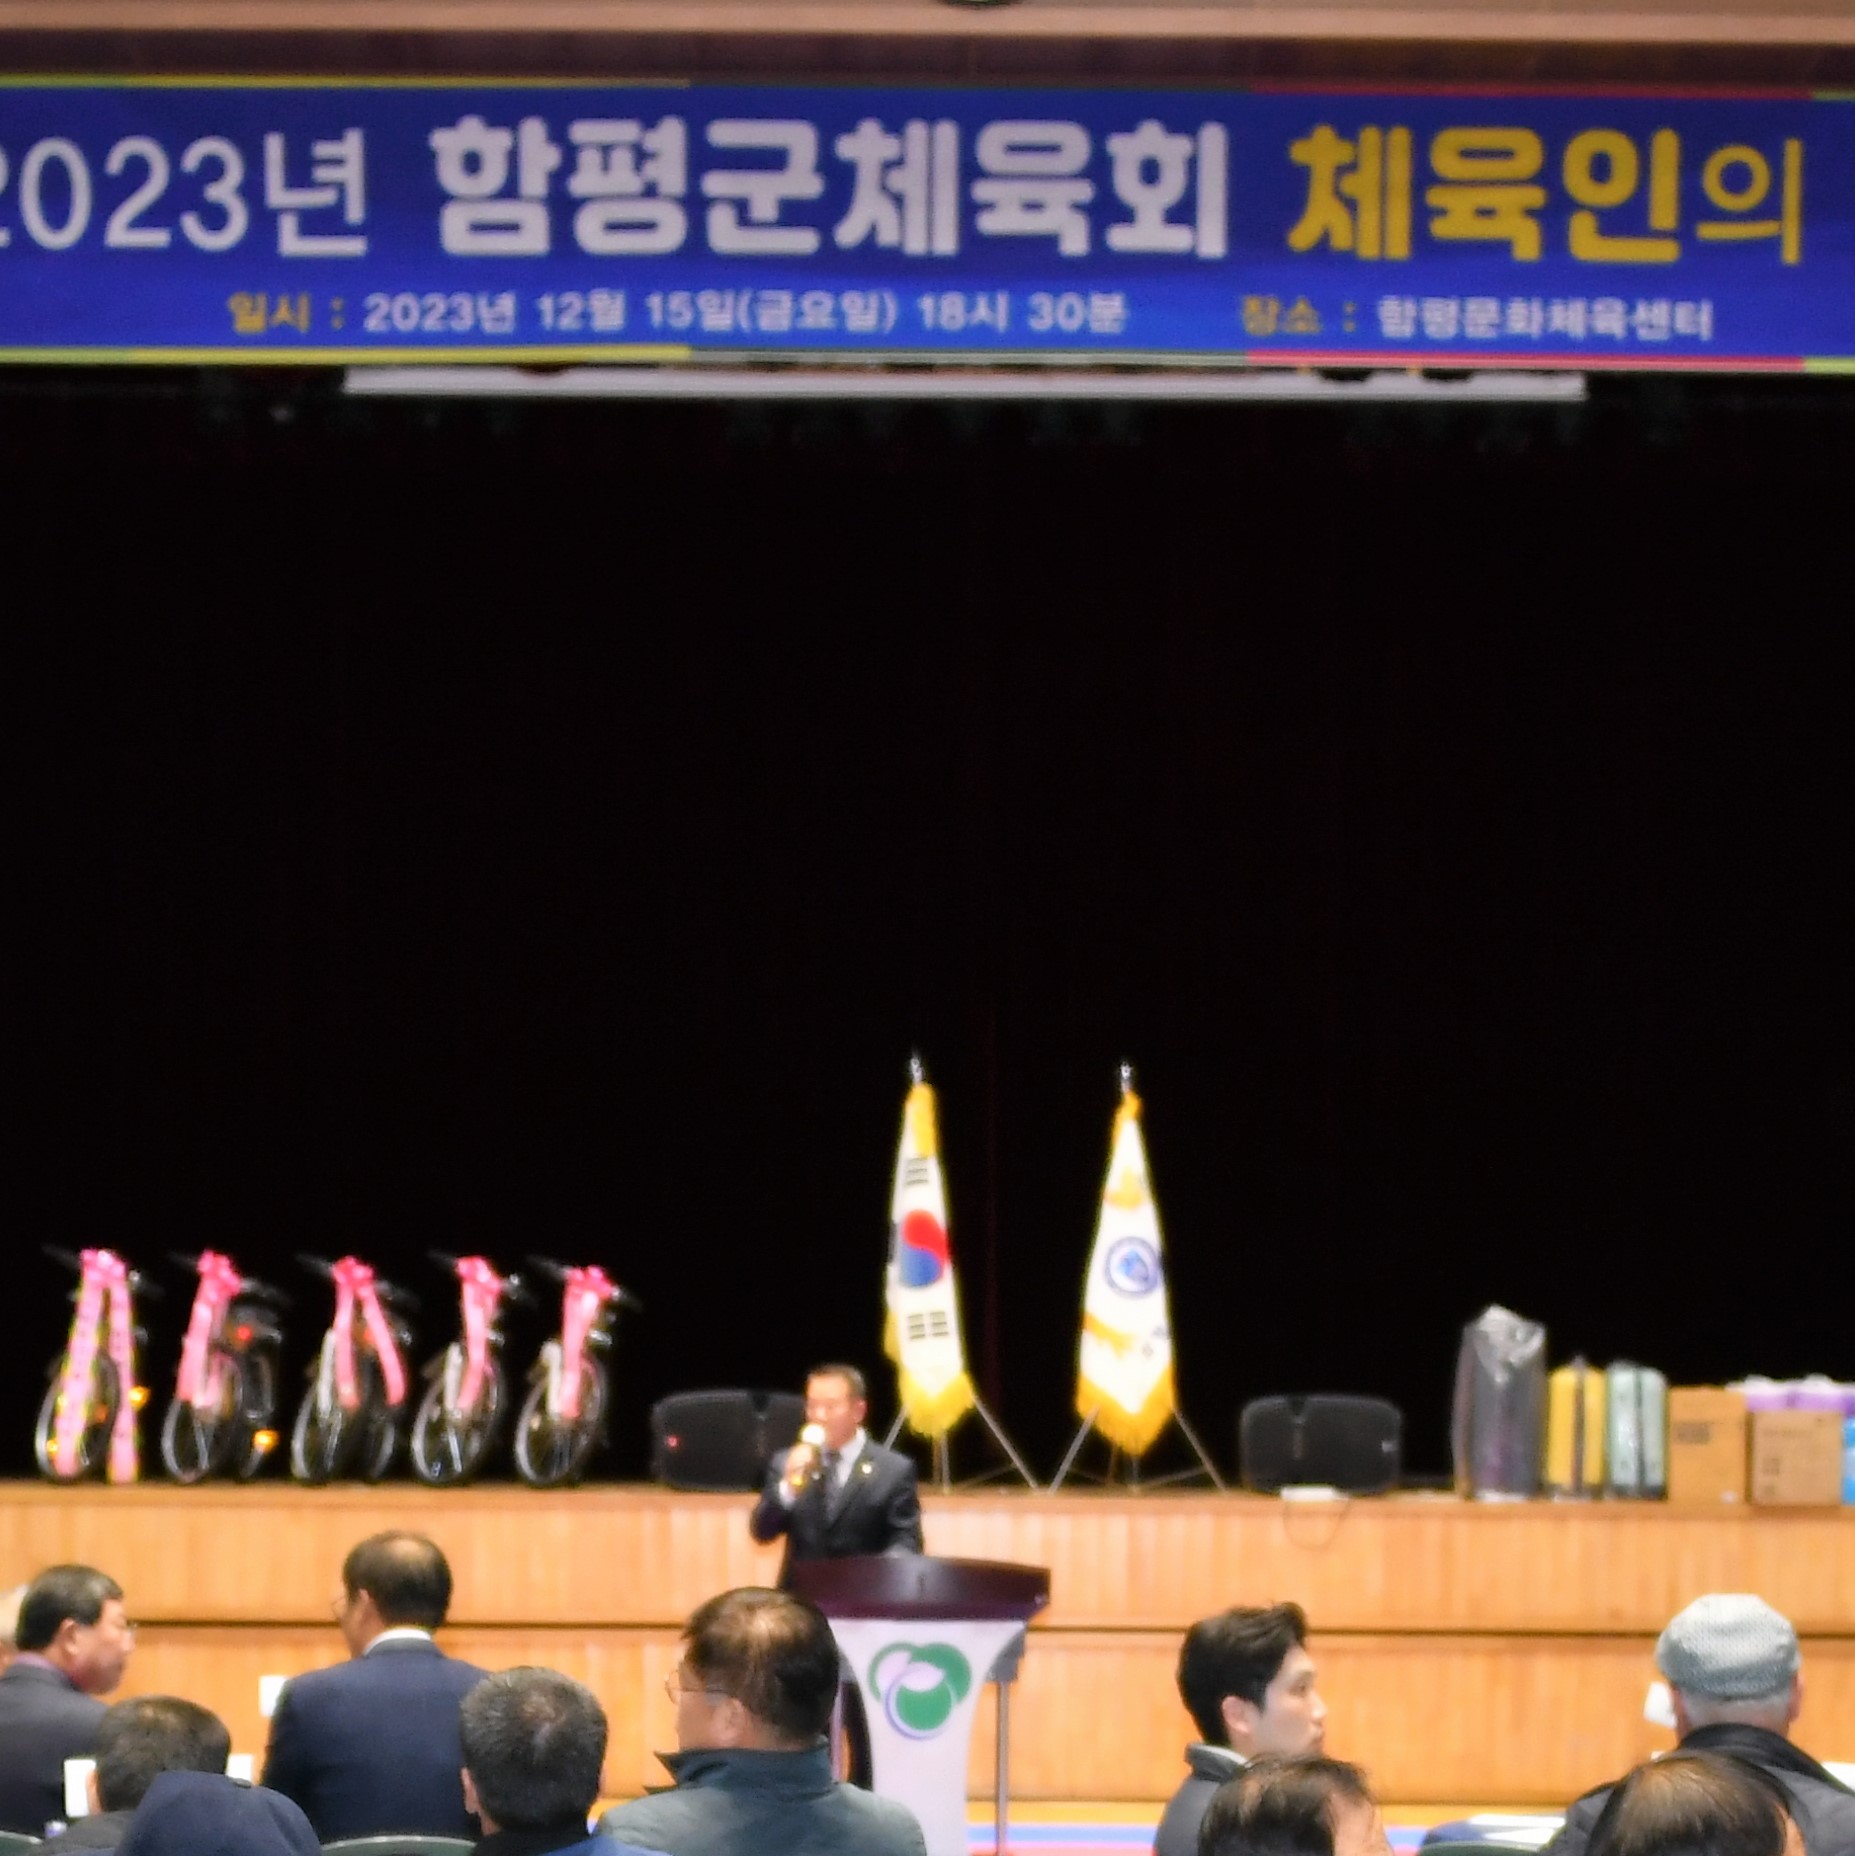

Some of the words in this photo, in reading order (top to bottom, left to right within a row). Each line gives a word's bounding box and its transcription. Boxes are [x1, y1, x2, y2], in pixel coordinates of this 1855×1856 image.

[428, 115, 1229, 261] 함평군체육회
[1286, 123, 1804, 266] 체육인의
[226, 291, 312, 335] 일시
[361, 290, 518, 334] 2023년
[537, 287, 628, 333] 12월
[645, 288, 899, 335] 15일(금요일)
[916, 290, 1011, 333] 18시
[1027, 290, 1129, 335] 30분
[1240, 293, 1323, 338] 장소
[1375, 293, 1717, 342] 함평문화체육센터
